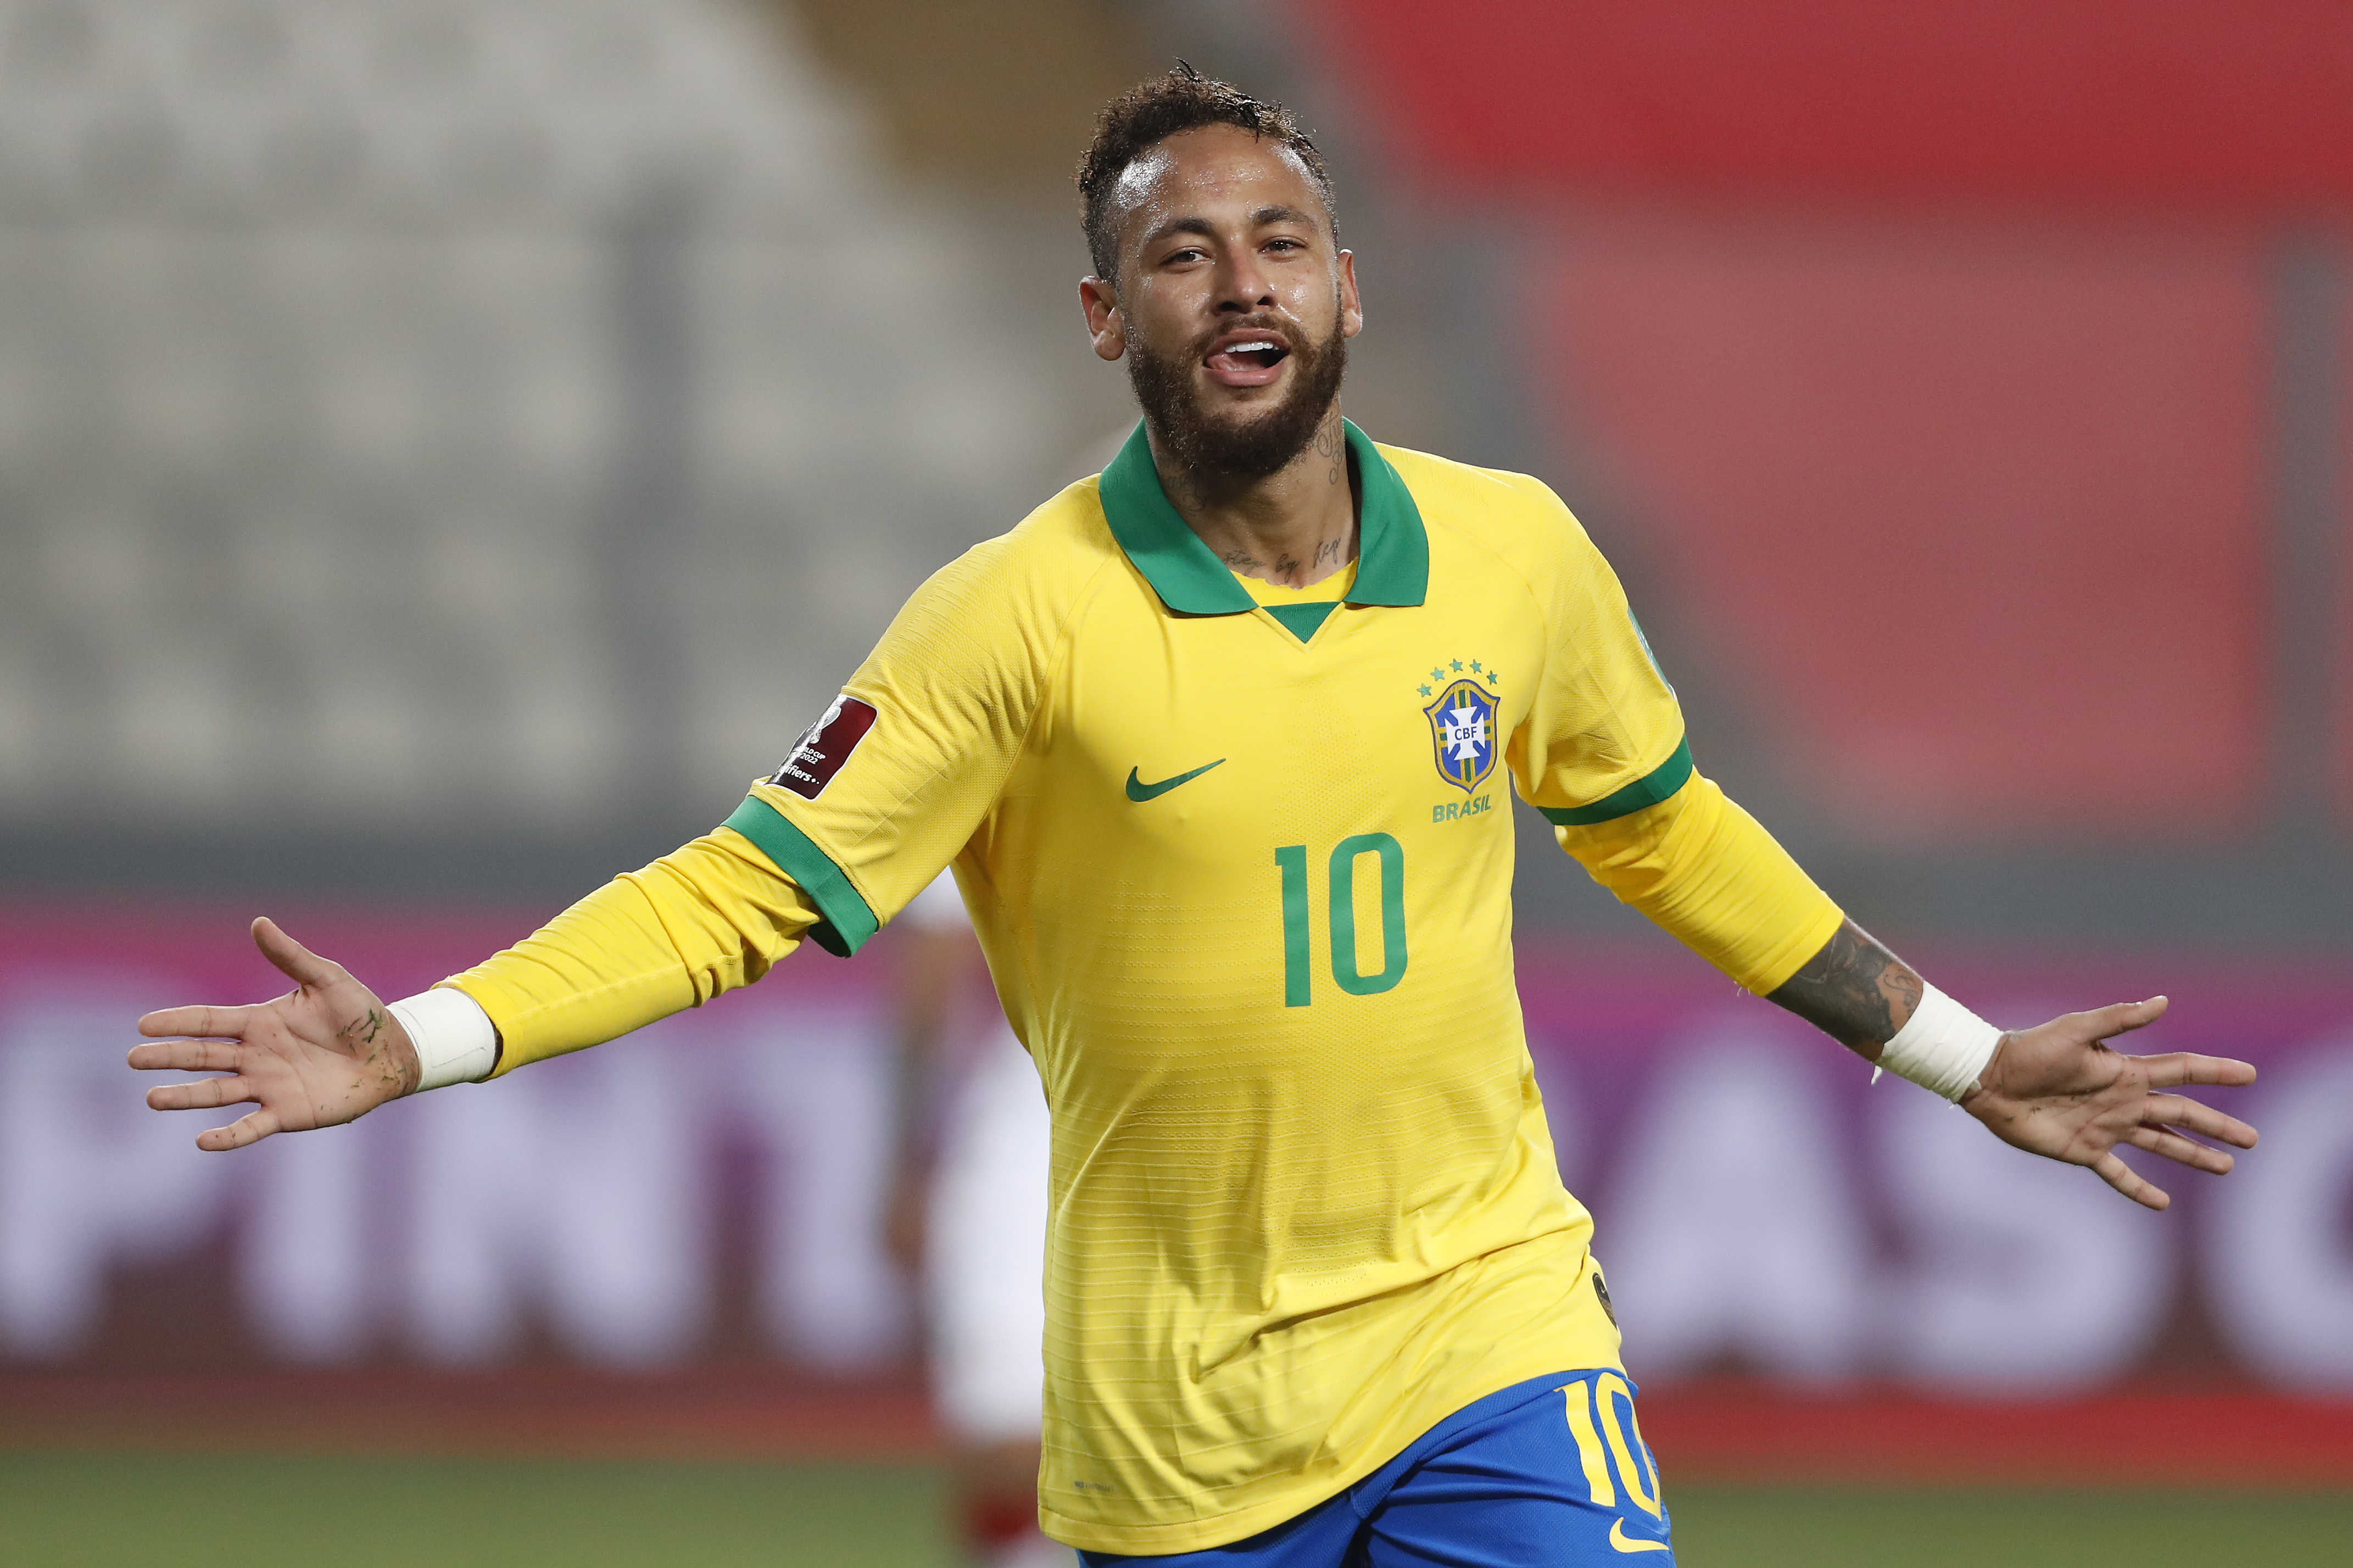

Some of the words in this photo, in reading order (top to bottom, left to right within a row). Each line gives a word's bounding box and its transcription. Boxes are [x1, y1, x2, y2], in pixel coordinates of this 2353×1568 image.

[1455, 727, 1477, 740] CBF
[813, 751, 826, 760] CUP
[1432, 795, 1491, 823] BRASIL
[1275, 832, 1408, 1007] 10
[1554, 1372, 1662, 1521] 10
